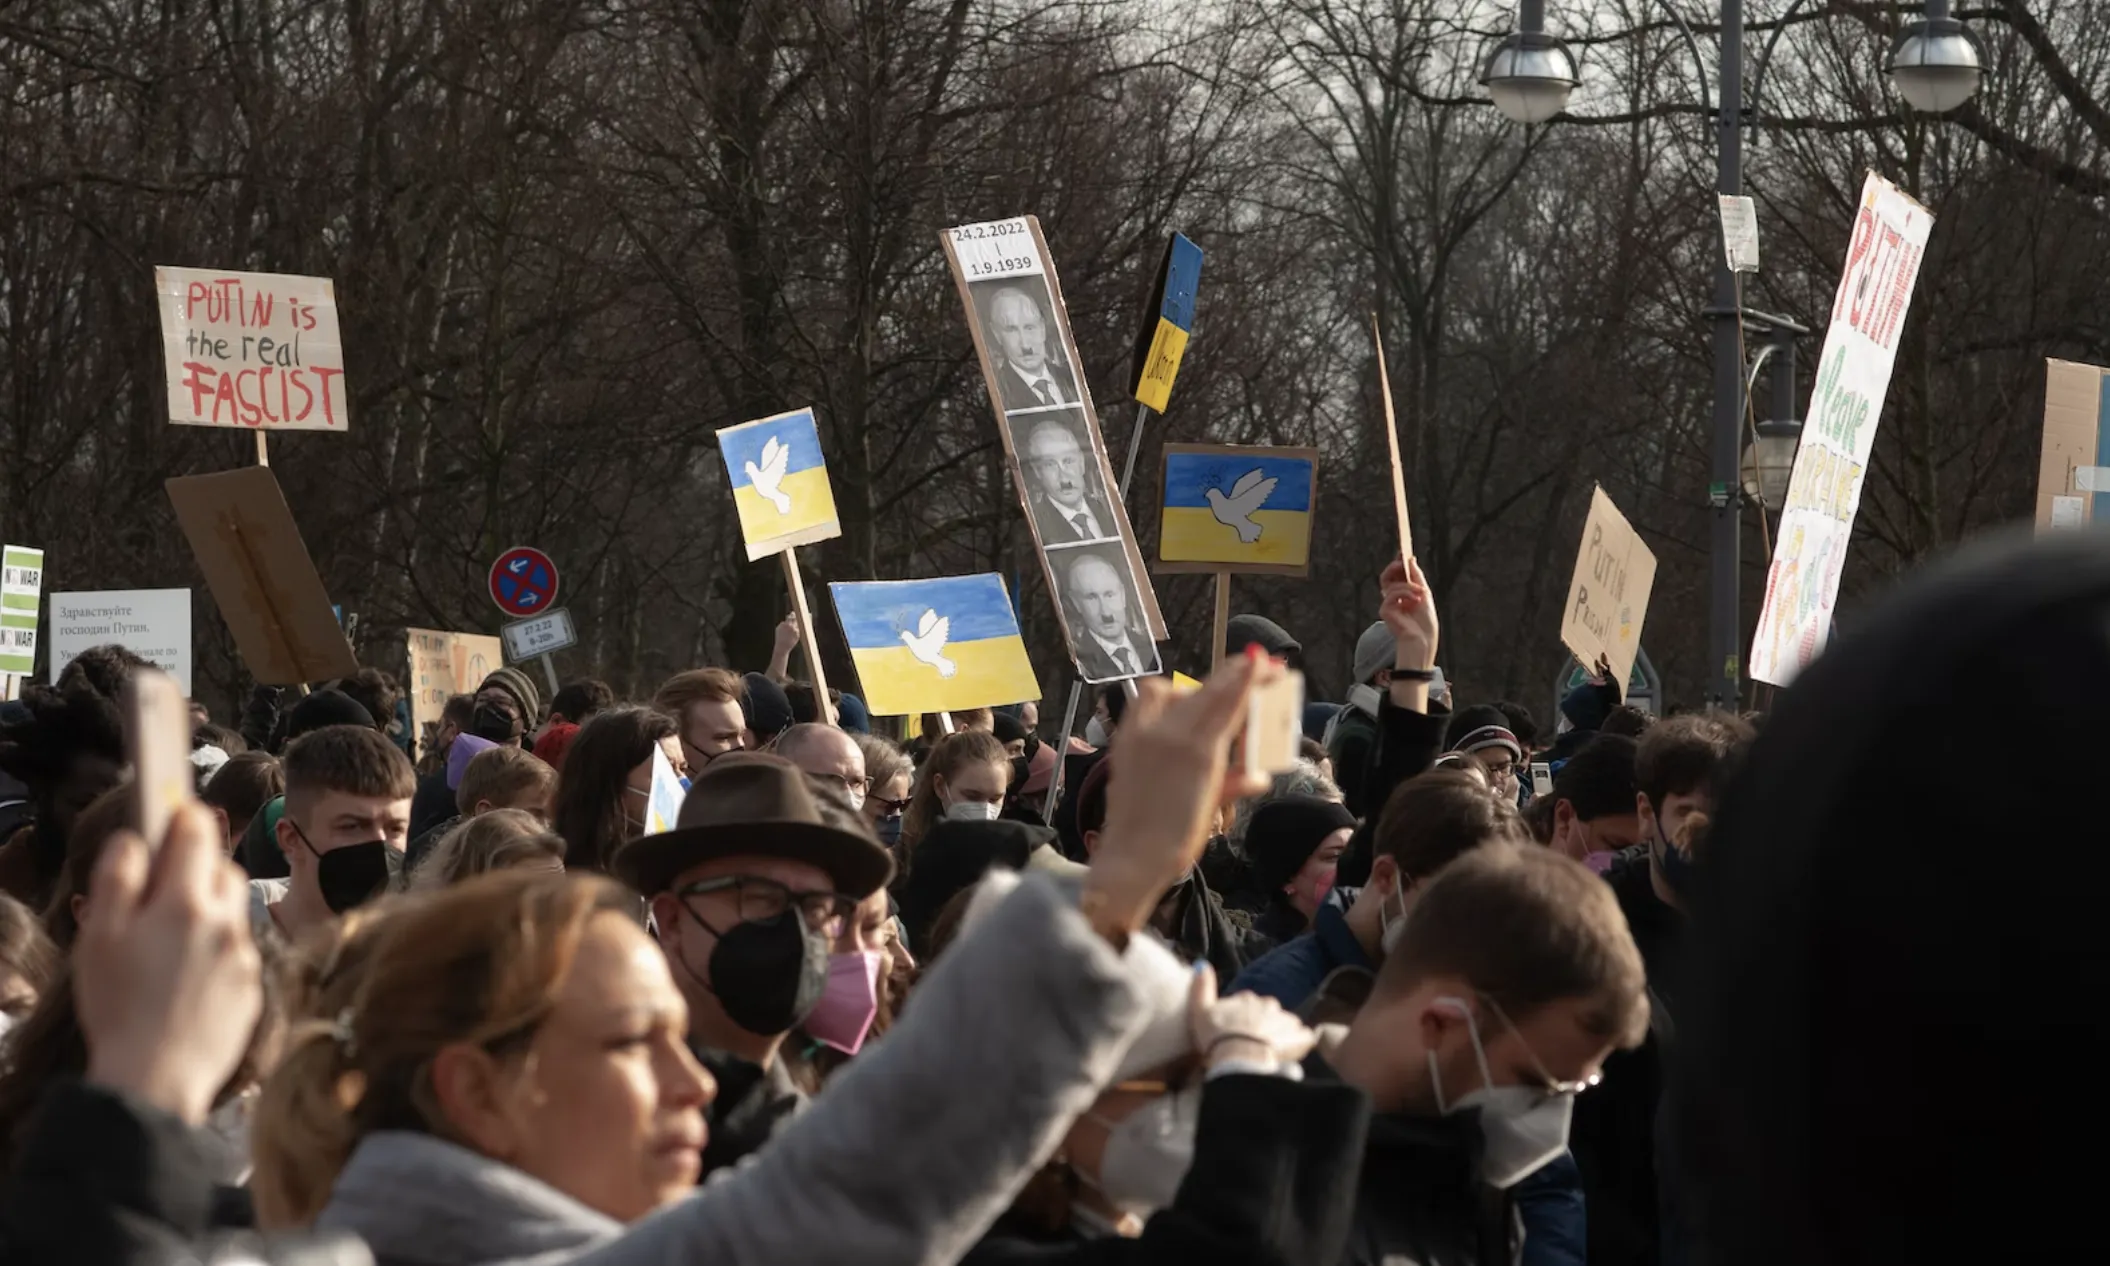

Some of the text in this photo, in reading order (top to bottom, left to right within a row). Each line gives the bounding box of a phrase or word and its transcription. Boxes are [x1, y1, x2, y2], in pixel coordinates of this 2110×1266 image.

[954, 222, 1025, 241] 24.2.2022
[971, 256, 1032, 275] 1.9.1939
[1834, 206, 1921, 350] PUTIN
[187, 278, 317, 330] PUTIN is
[186, 328, 300, 367] the real
[182, 361, 345, 426] FASCIST
[20, 570, 38, 587] WAR
[60, 606, 132, 620] Здравствуйте
[14, 631, 33, 648] WAR
[60, 625, 110, 636] господин
[166, 647, 178, 657] по
